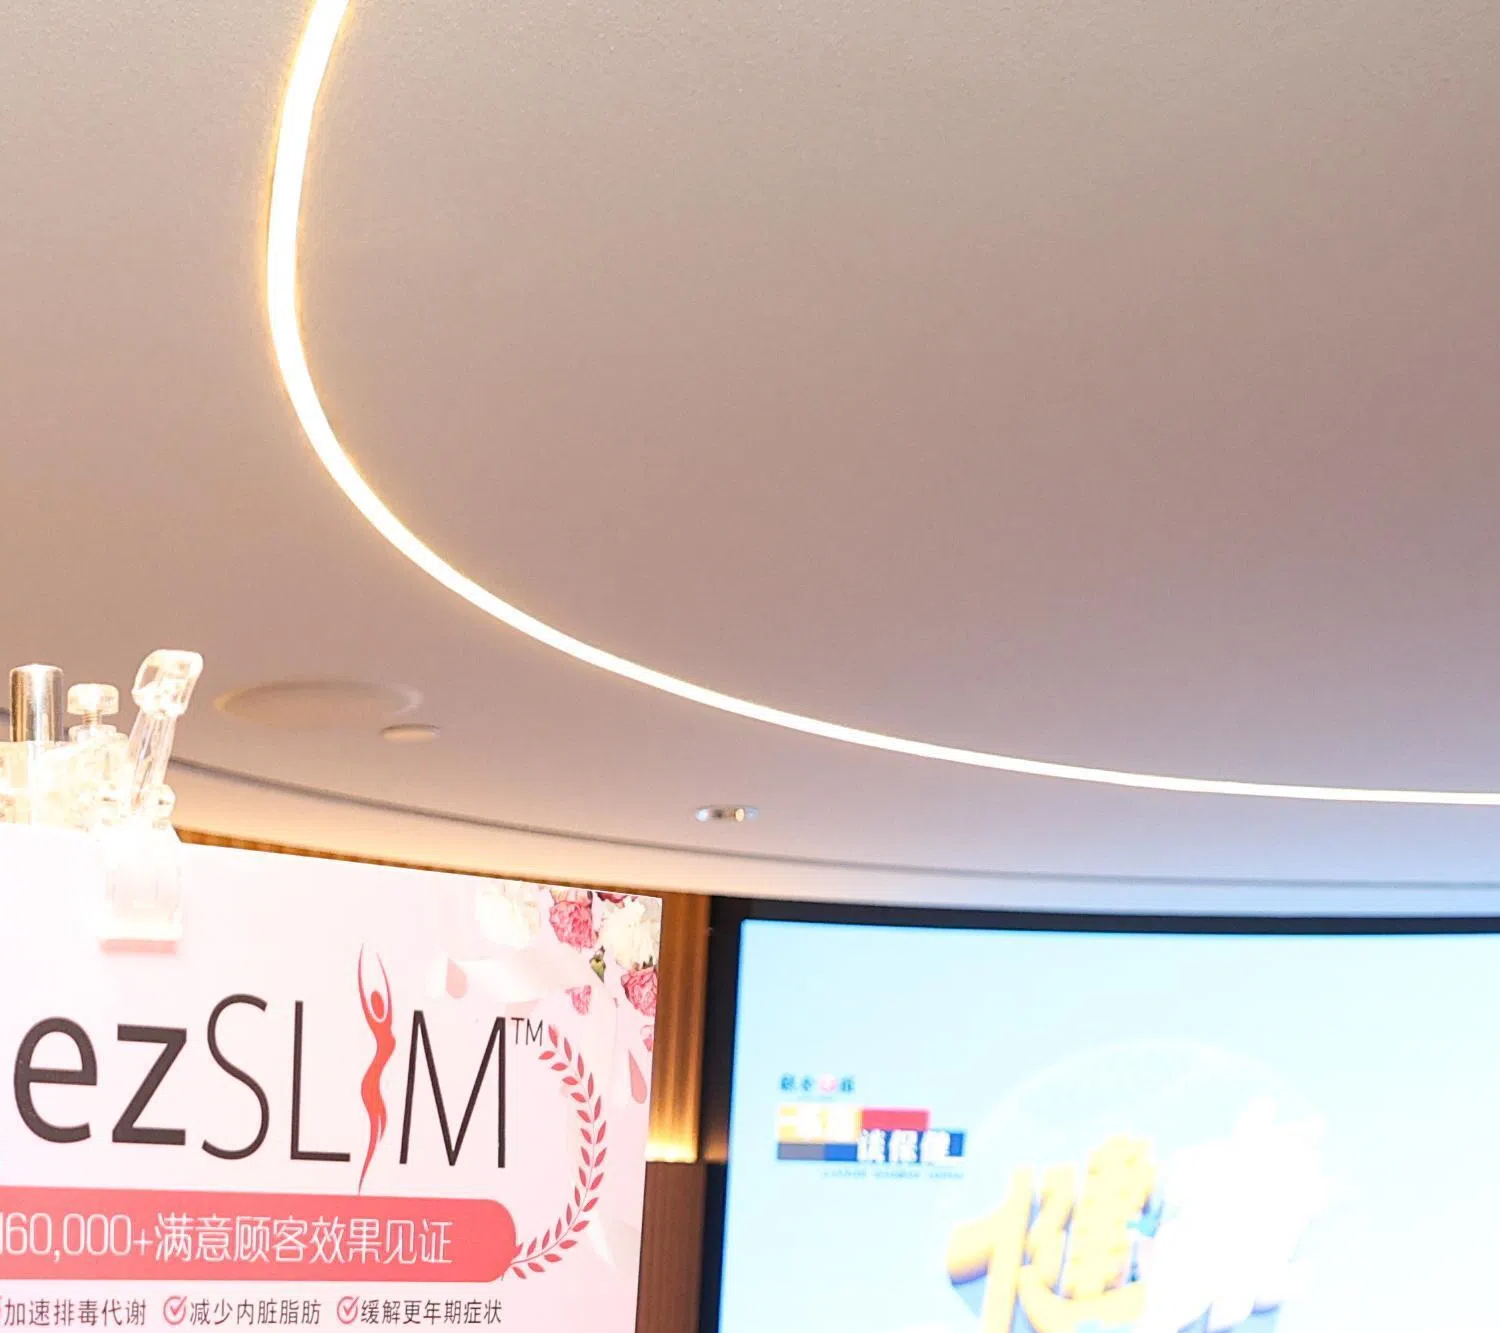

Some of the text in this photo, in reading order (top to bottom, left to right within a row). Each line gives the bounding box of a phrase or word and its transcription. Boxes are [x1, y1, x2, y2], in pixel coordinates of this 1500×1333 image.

[4, 1298, 146, 1327] 加速排毒代谢
[189, 1298, 322, 1326] 减少内脏脂肪
[361, 1298, 502, 1325] 缓解更年期症状
